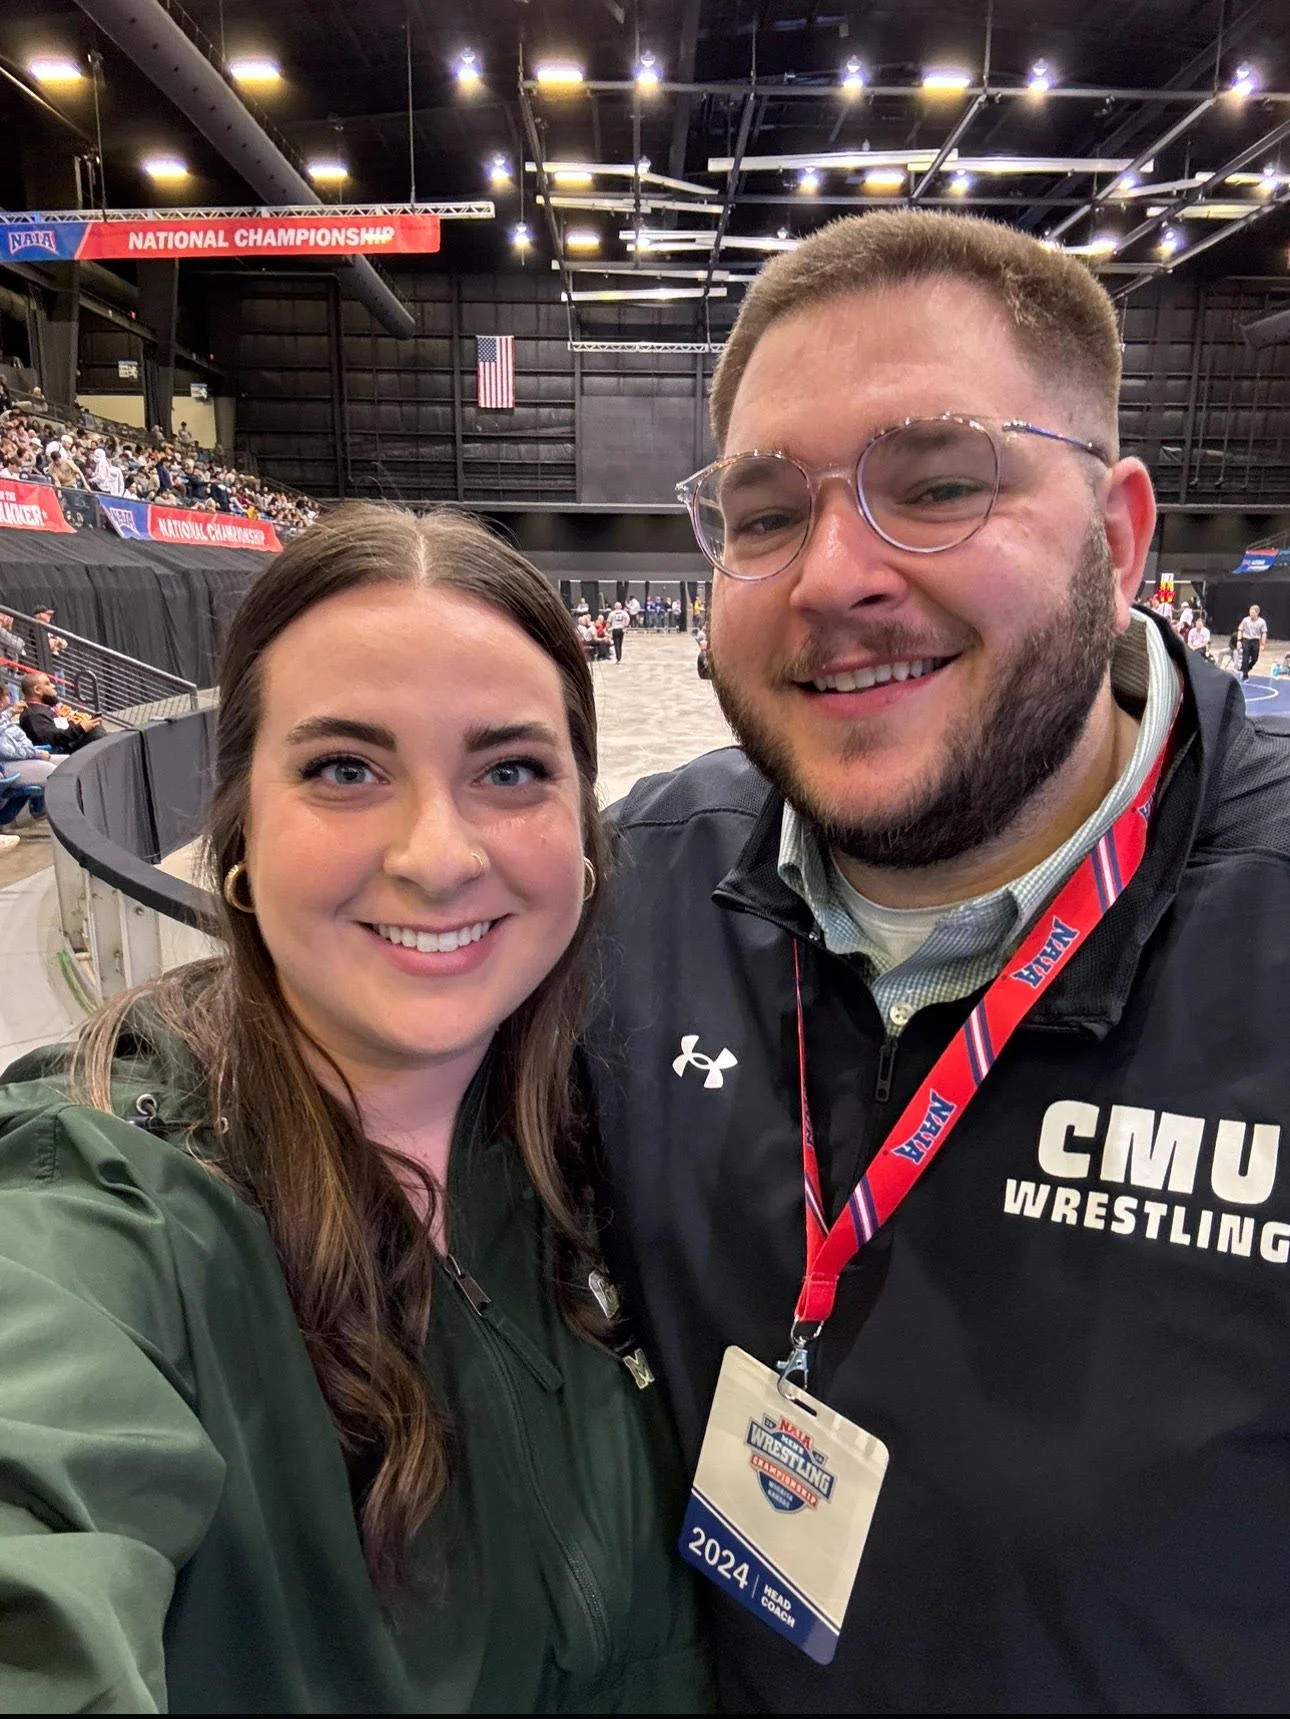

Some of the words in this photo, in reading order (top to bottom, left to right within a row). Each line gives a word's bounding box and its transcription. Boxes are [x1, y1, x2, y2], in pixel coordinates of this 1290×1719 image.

[9, 230, 57, 254] NAIA
[128, 231, 228, 250] NATIONAL
[234, 227, 395, 248] CHAMPIONSHIP
[158, 518, 208, 541] NATIONAL
[207, 523, 265, 545] CHAMPIONSHIP
[1010, 915, 1080, 989] NAIA
[891, 1088, 957, 1166] NAIA
[1038, 1100, 1281, 1205] CMU
[1003, 1178, 1290, 1264] WRESTLING
[780, 1418, 813, 1449] NAIA
[750, 1424, 831, 1495] WRESTLING
[752, 1456, 817, 1505] CHAMPIONSHIP
[688, 1527, 750, 1589] 2024
[761, 1596, 796, 1629] COACH
[763, 1584, 792, 1611] HEAD
